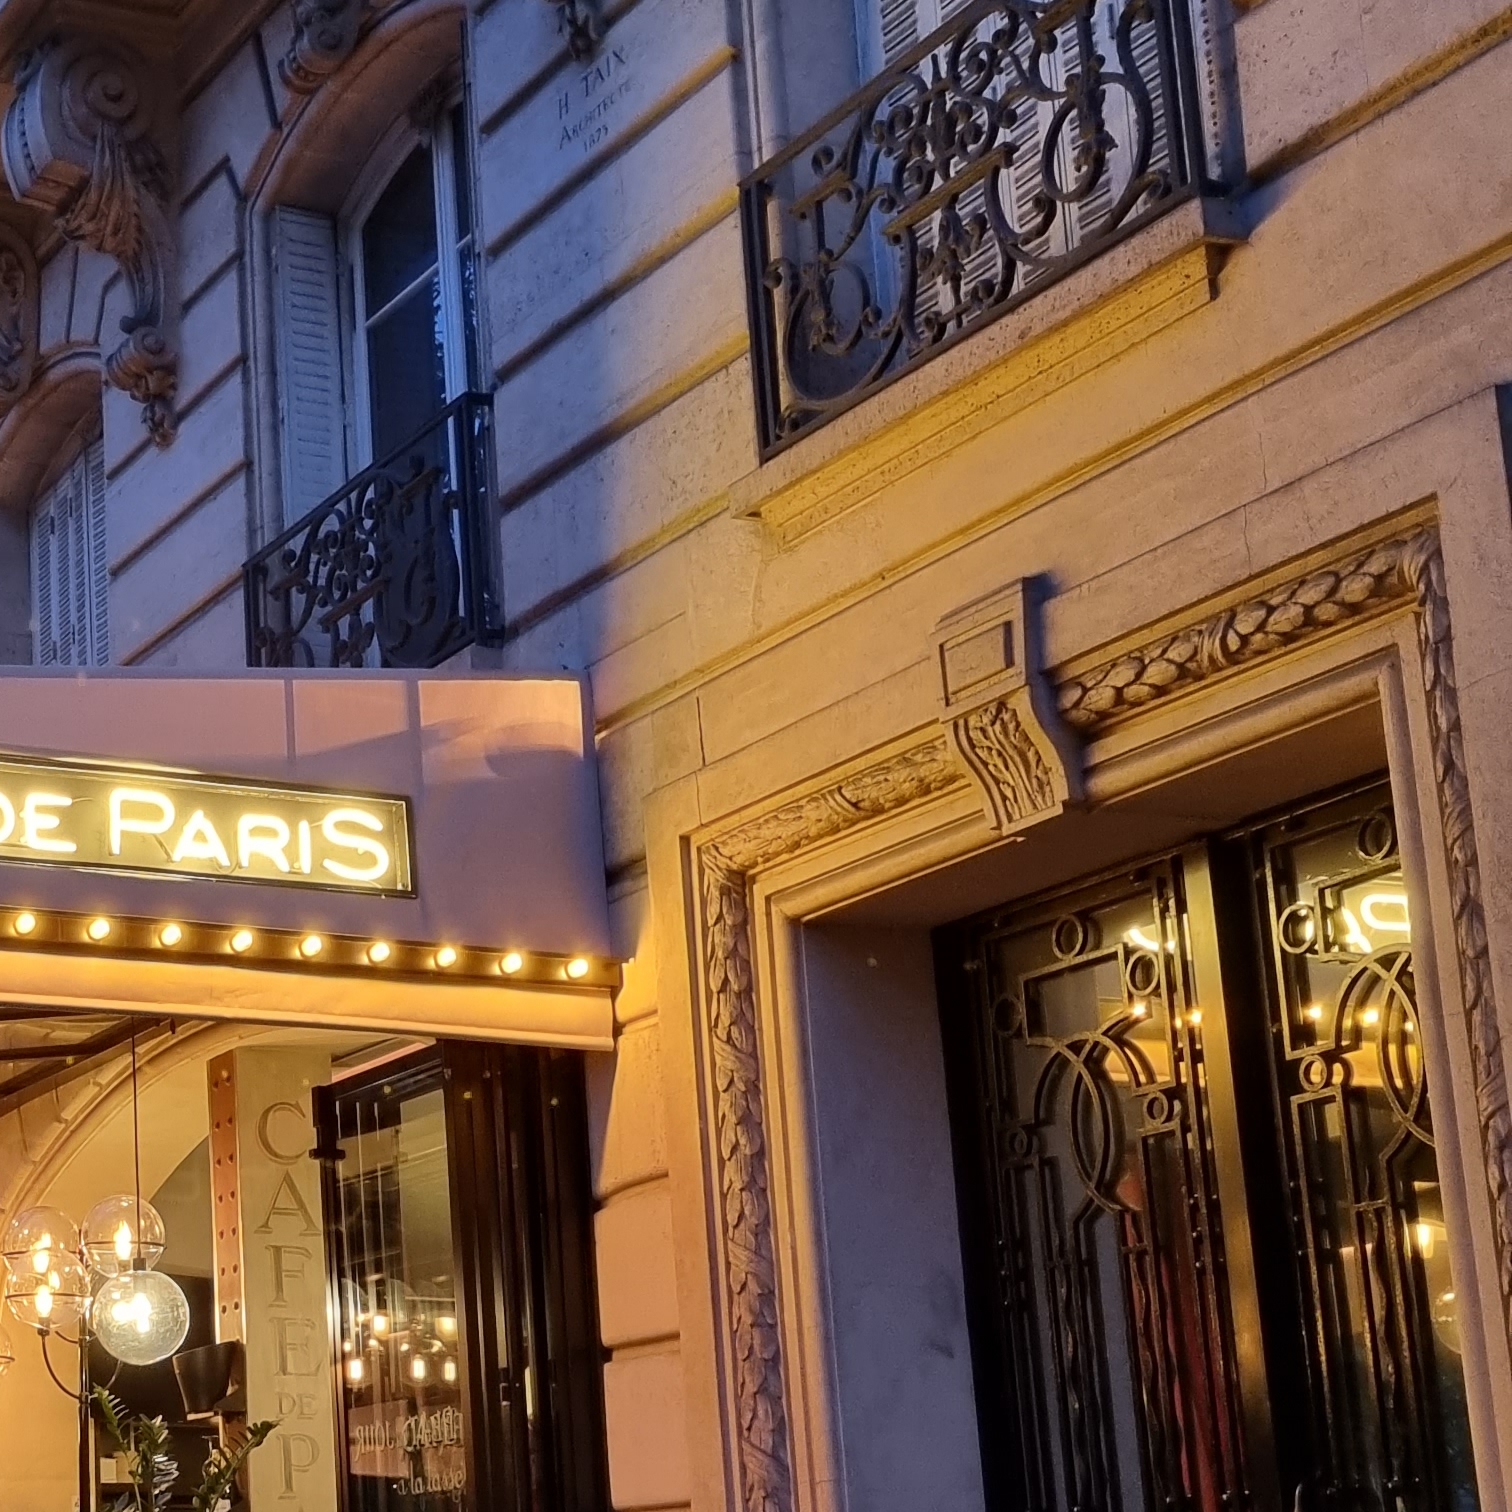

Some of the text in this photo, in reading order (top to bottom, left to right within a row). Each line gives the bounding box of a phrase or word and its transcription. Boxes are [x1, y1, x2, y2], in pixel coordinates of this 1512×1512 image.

[558, 90, 569, 120] H
[108, 787, 391, 882] PARIS
[254, 1100, 323, 1378] CAFE
[276, 1391, 317, 1421] DE
